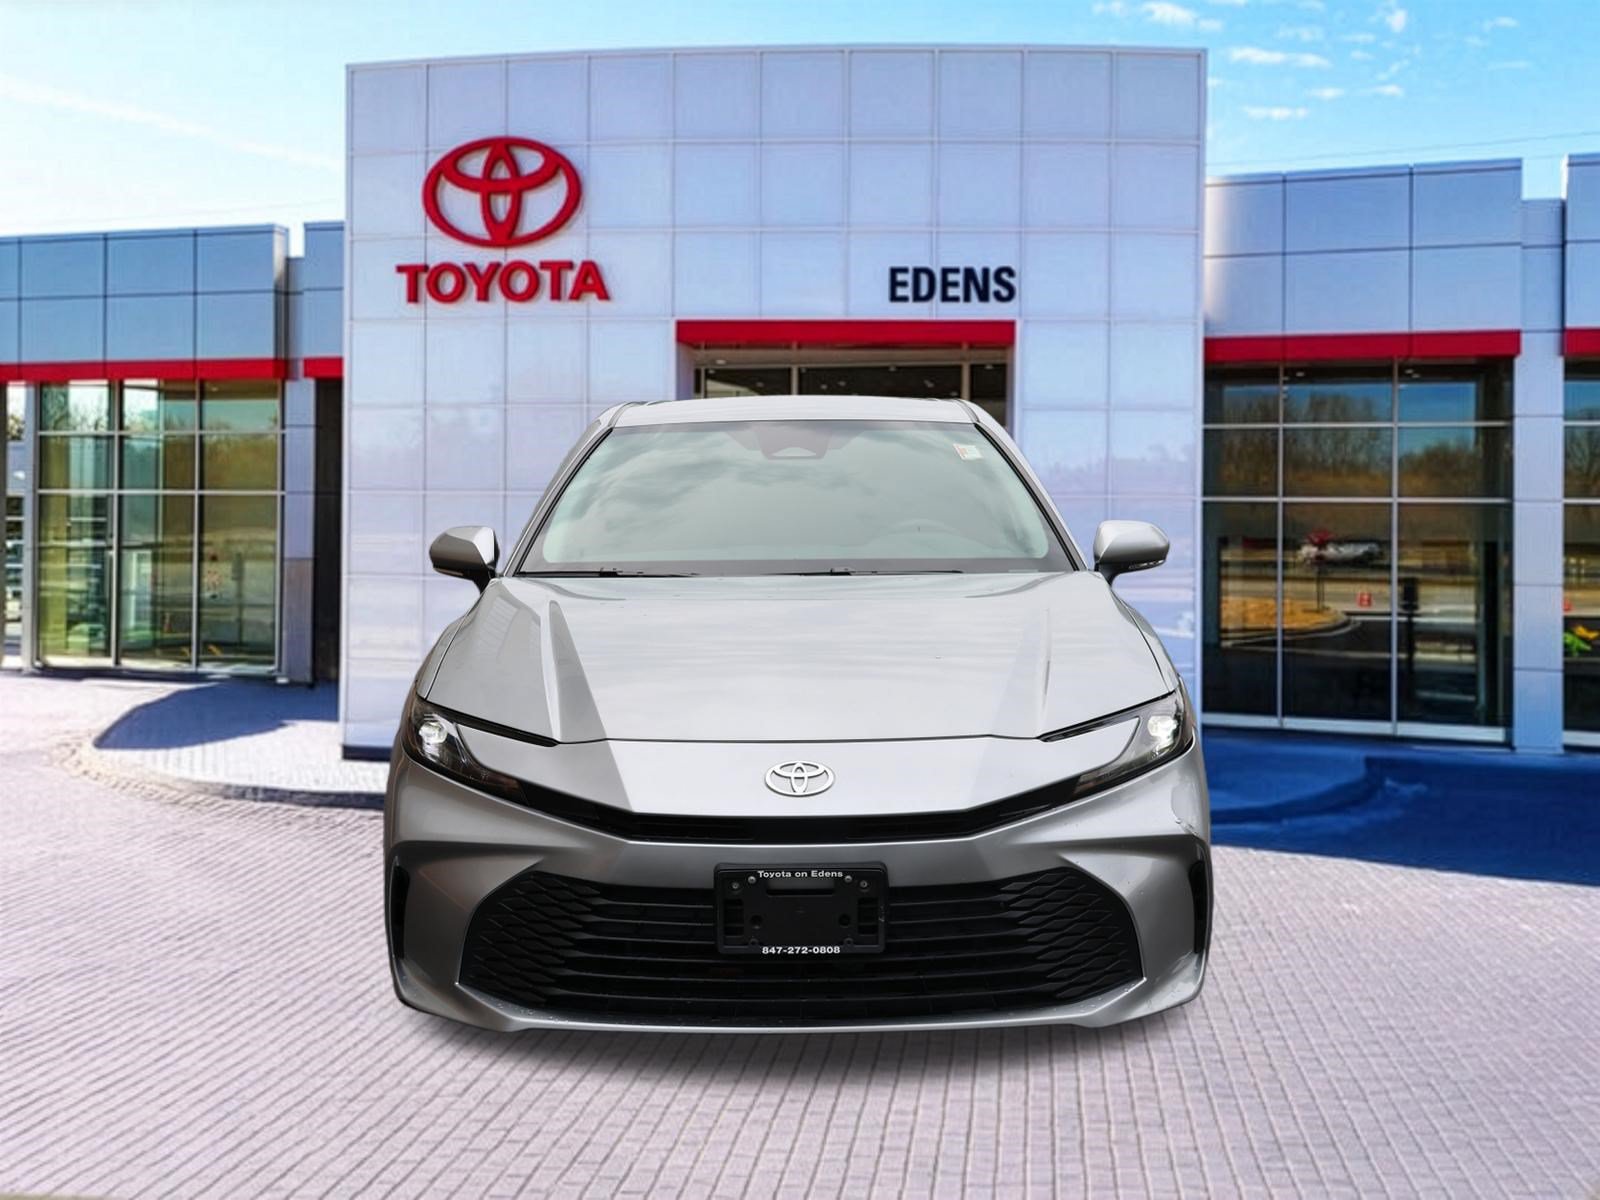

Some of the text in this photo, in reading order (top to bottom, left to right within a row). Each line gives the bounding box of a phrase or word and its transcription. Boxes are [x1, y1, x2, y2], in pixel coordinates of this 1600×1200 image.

[396, 260, 611, 304] TOYOTA
[888, 266, 1017, 303] EDENS
[757, 870, 792, 879] Toyota
[810, 870, 844, 878] Edens
[761, 946, 841, 955] 847-272-0808
